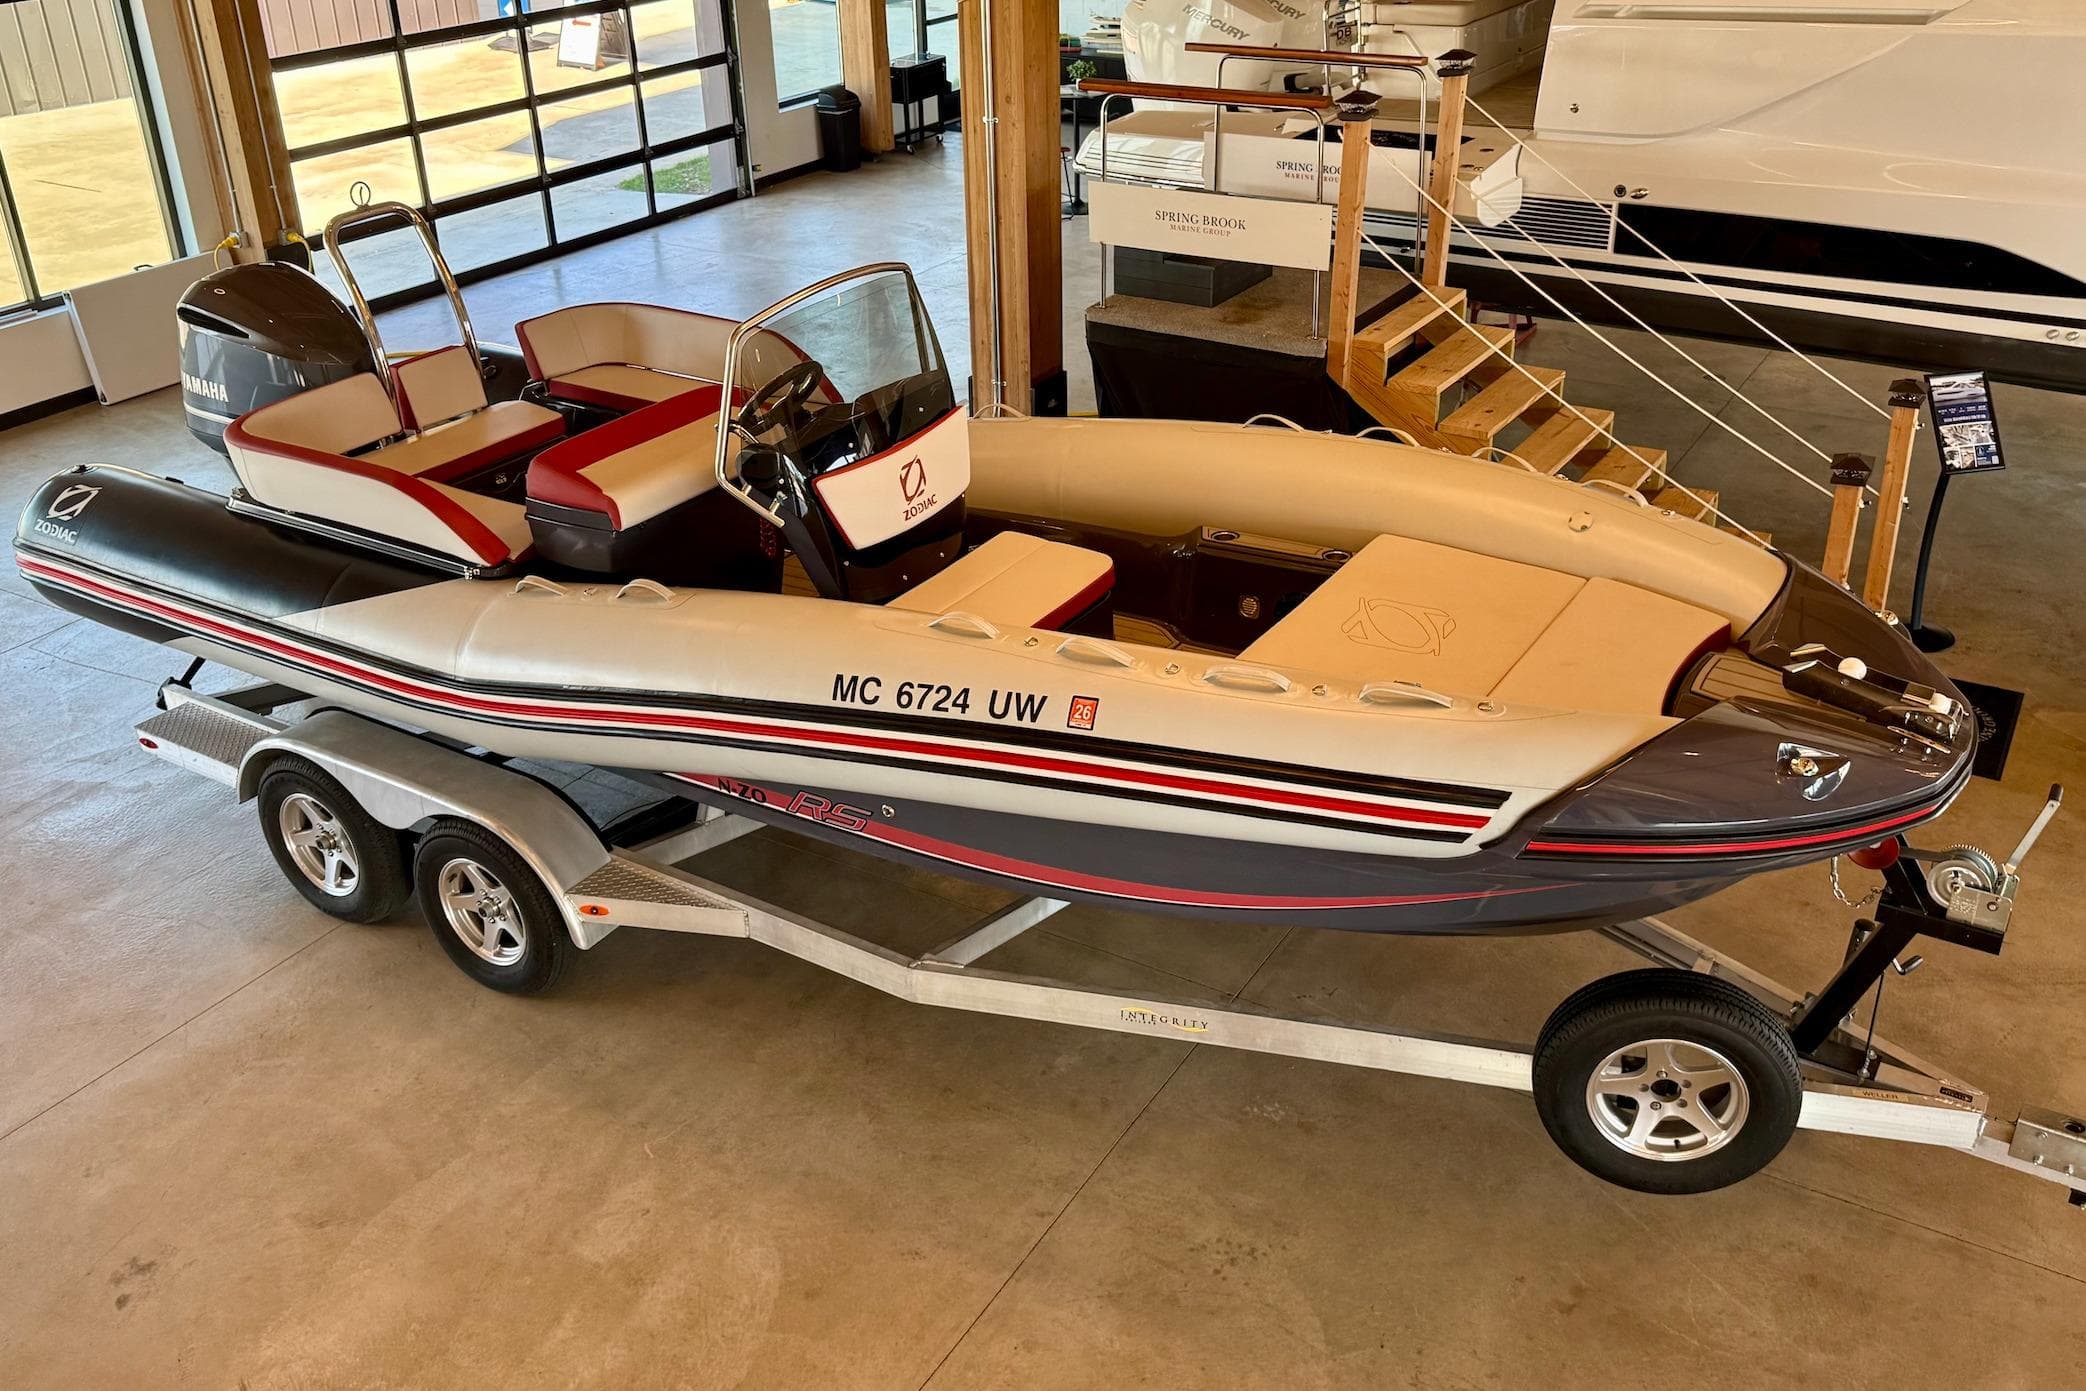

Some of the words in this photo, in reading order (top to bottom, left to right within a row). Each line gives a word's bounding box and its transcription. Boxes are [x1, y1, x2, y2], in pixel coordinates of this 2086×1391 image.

[1182, 4, 1250, 41] MERCURY
[1276, 160, 1313, 173] SPRING
[1284, 172, 1315, 181] MARINE
[1155, 210, 1199, 225] SPRING
[1202, 215, 1246, 230] BROOK
[1169, 224, 1200, 233] MARINE
[1203, 227, 1231, 237] GROUP
[183, 371, 229, 402] YAMAHA
[903, 494, 938, 521] ZODIAC
[34, 518, 77, 543] ZODIAC
[831, 673, 882, 705] MC
[895, 681, 970, 714] 6724
[988, 689, 1048, 723] UW
[1073, 704, 1092, 720] 26
[786, 791, 874, 831] RS
[1120, 1009, 1208, 1029] INTEGRITY
